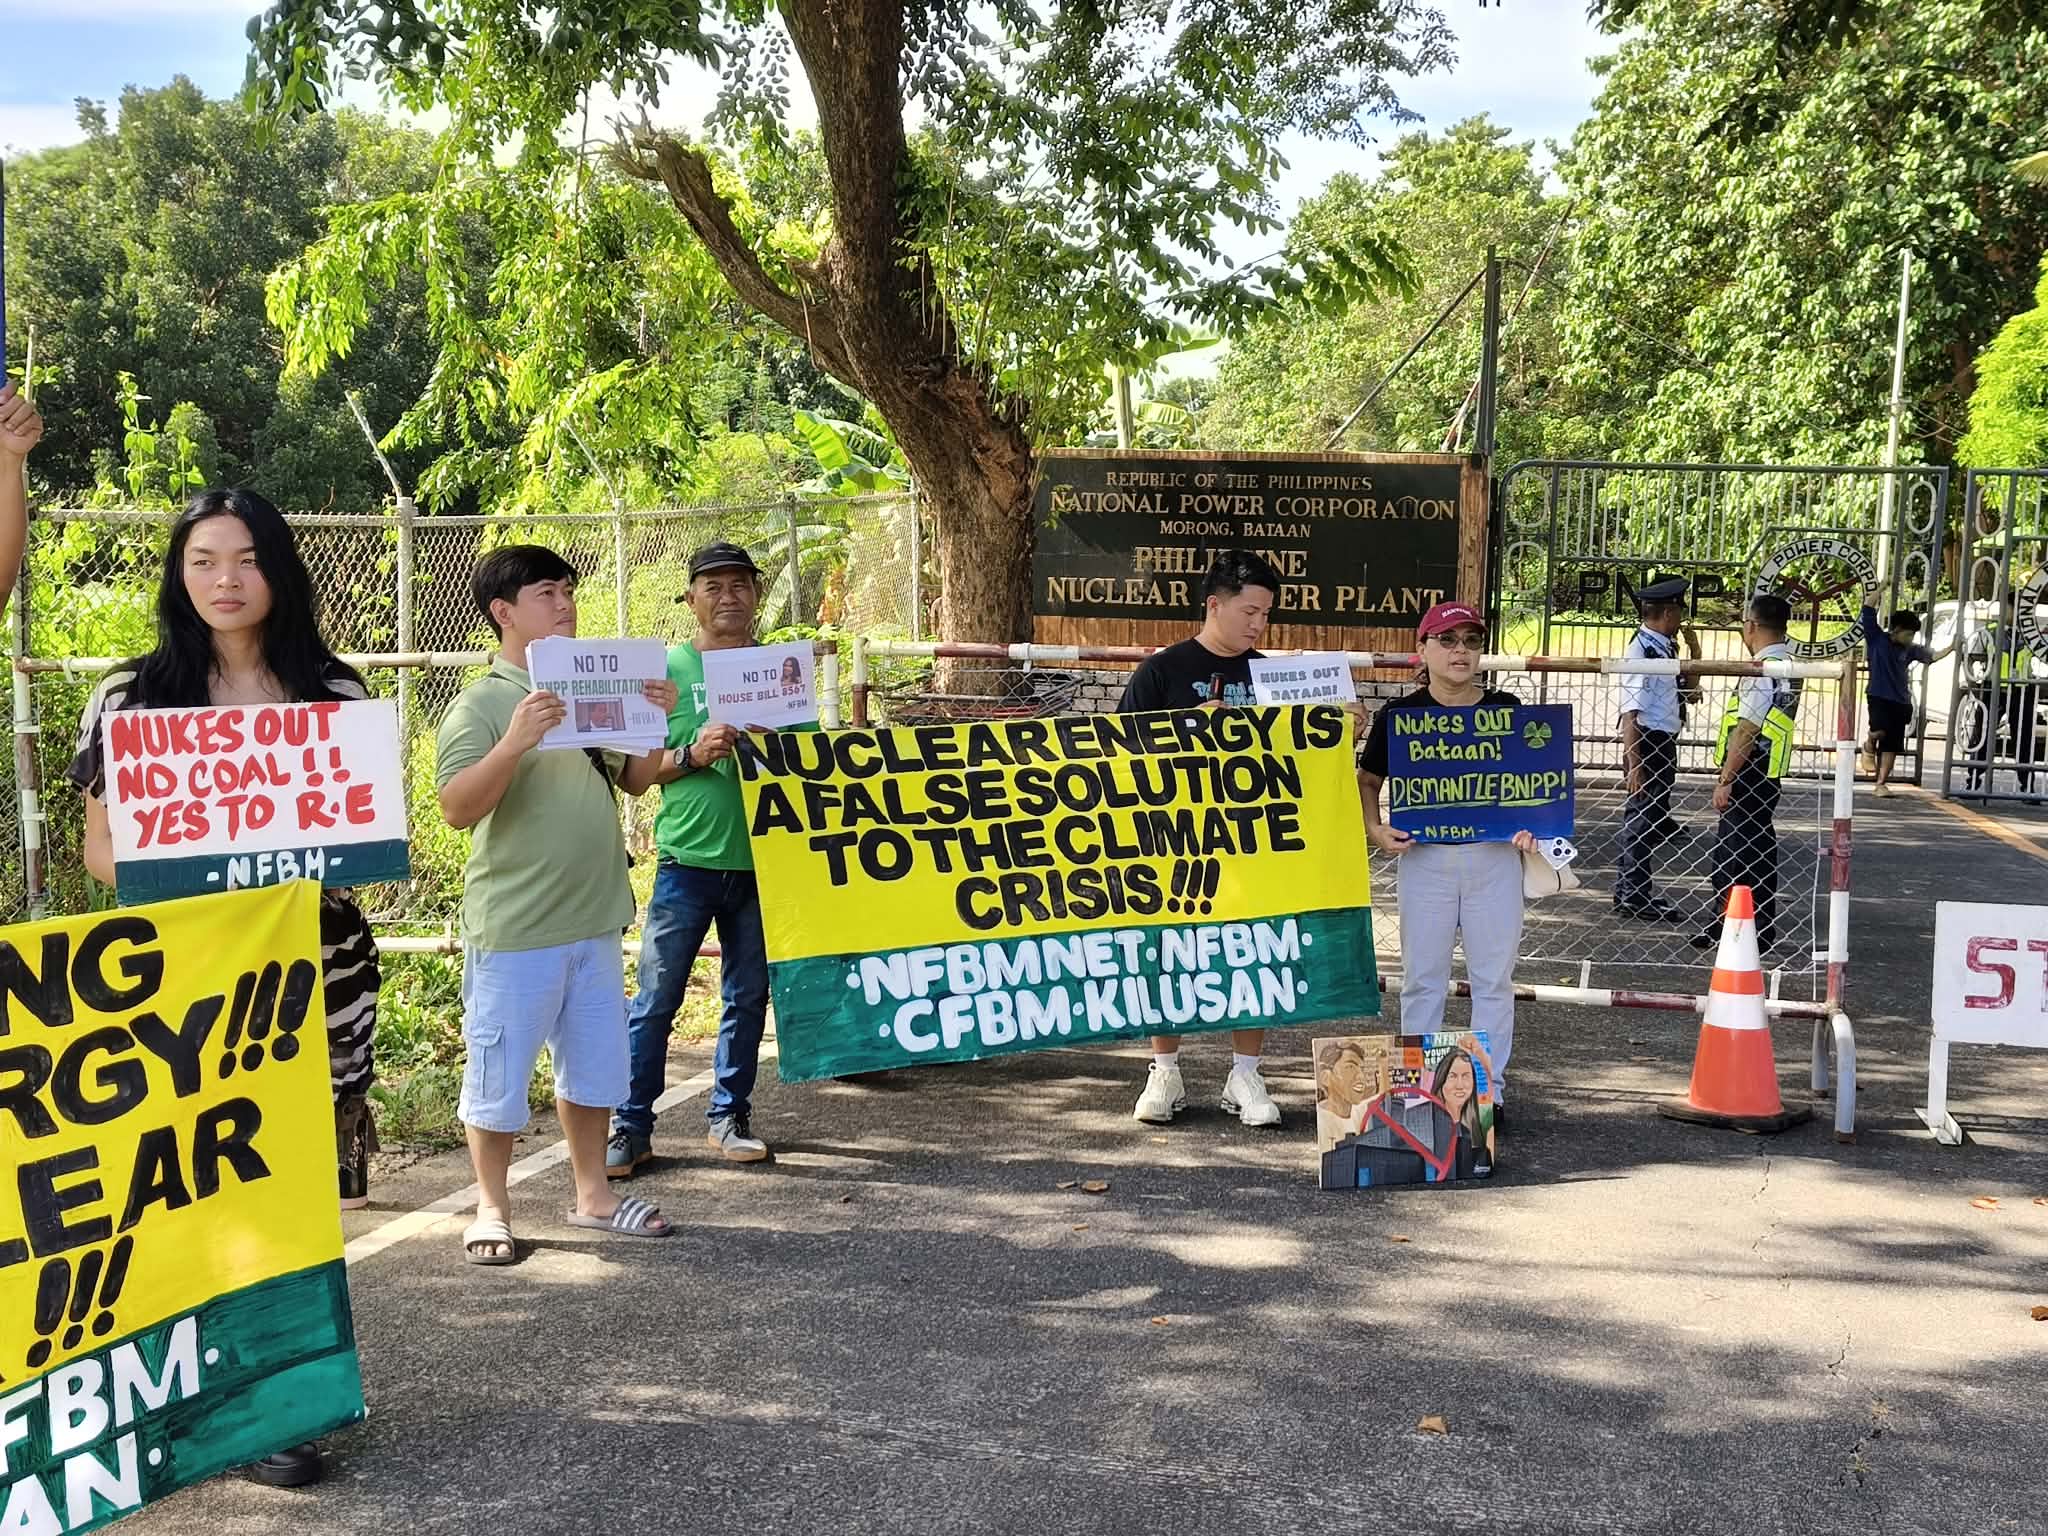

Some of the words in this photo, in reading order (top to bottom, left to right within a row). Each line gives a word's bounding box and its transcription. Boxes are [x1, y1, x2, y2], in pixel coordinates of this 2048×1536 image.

[1106, 471, 1186, 488] REPUBLIC
[1194, 473, 1217, 489] OF
[1226, 474, 1259, 490] THE
[1268, 475, 1373, 491] PHILIPPINES
[1050, 491, 1169, 514] NATIONAL
[1178, 494, 1265, 516] POWER
[1275, 496, 1456, 520] CORPORATION
[1243, 522, 1312, 538] BATAAN
[1134, 546, 1308, 577] PHILINE
[1773, 540, 1833, 568] POWER
[1047, 576, 1191, 607] NUCLEAR
[1334, 584, 1445, 614] PLANT
[573, 655, 595, 673] NO
[600, 654, 619, 673] TO
[1794, 643, 1838, 657] 1936
[571, 678, 645, 696] REHABILITATIO
[742, 671, 759, 684] NO
[763, 668, 777, 681] TO
[1260, 671, 1307, 684] NUKES
[1312, 666, 1341, 679] OUT
[718, 691, 753, 705] HOUSE
[757, 689, 779, 700] BILL
[782, 684, 806, 698] 8567
[110, 709, 245, 762] NUKES
[254, 701, 341, 746] OUT
[1394, 711, 1465, 736] Nukes
[1474, 707, 1515, 733] OUT
[735, 720, 1060, 782] NUCLEAR
[1054, 706, 1281, 760] ENERGY
[1290, 704, 1344, 750] IS
[1409, 737, 1503, 762] Bataan!
[117, 762, 178, 804] NO
[751, 782, 804, 837] A
[801, 768, 1012, 831] FALSE
[1014, 752, 1303, 817] SOLUTION
[1500, 770, 1568, 803] BNPP!
[132, 799, 211, 849] YES
[216, 794, 275, 841] TO
[809, 827, 914, 887] TO
[912, 819, 1055, 873] THE
[1054, 802, 1306, 866] CLIMATE
